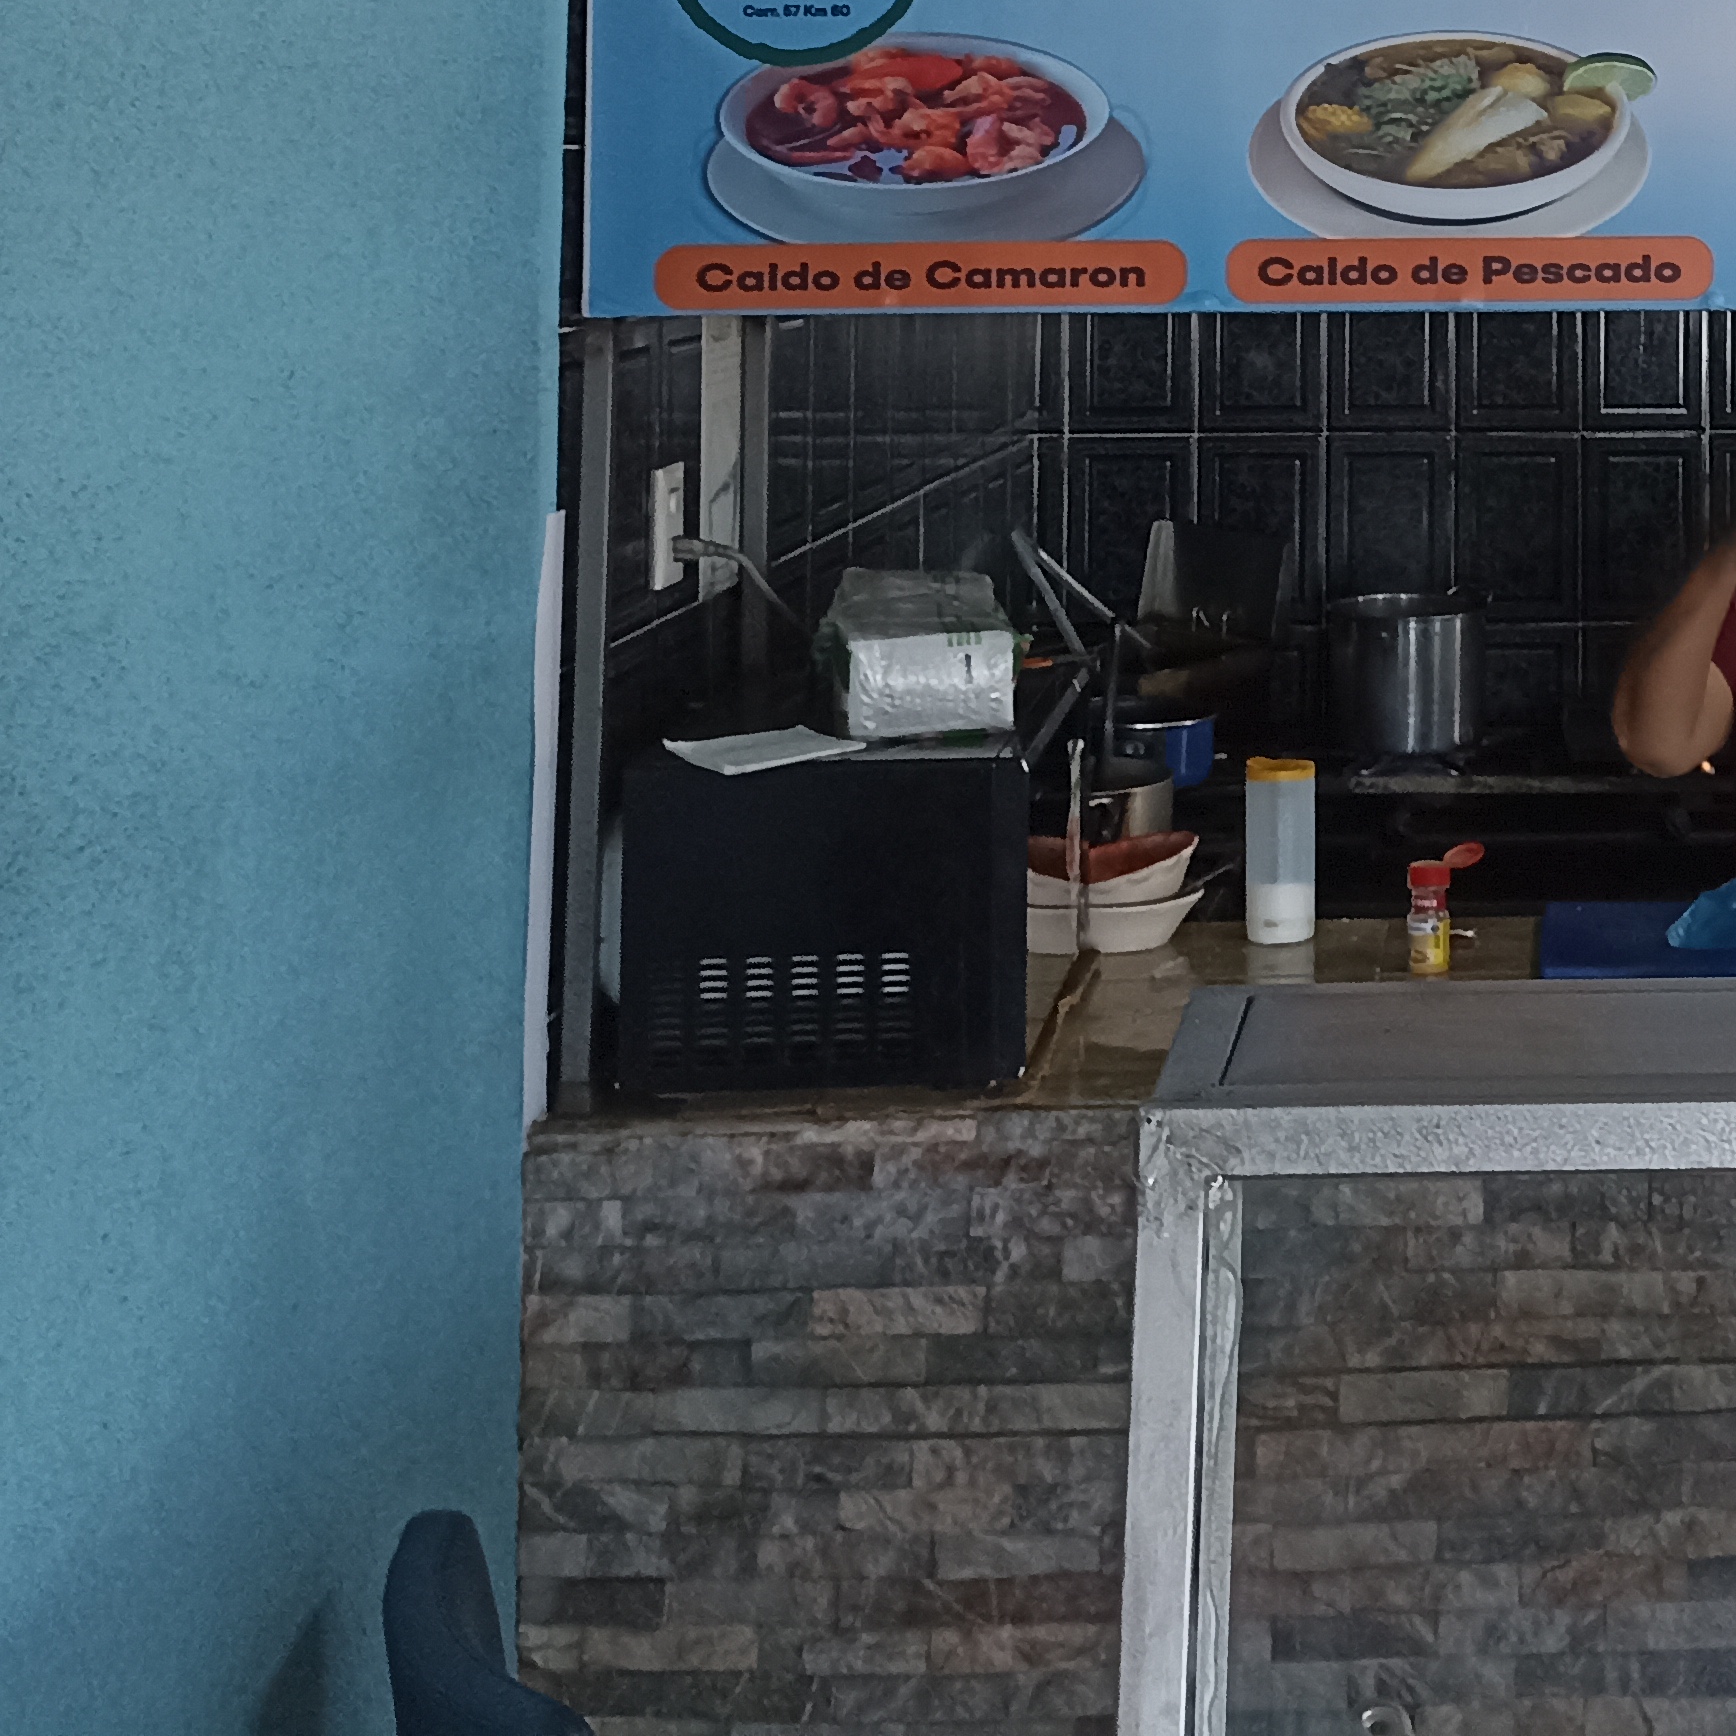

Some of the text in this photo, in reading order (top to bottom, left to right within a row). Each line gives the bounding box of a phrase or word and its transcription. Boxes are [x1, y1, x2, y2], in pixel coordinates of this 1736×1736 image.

[803, 4, 828, 17] Km
[695, 260, 1147, 293] Caldo de Camaron
[1257, 255, 1682, 287] Caldo de Pescado
